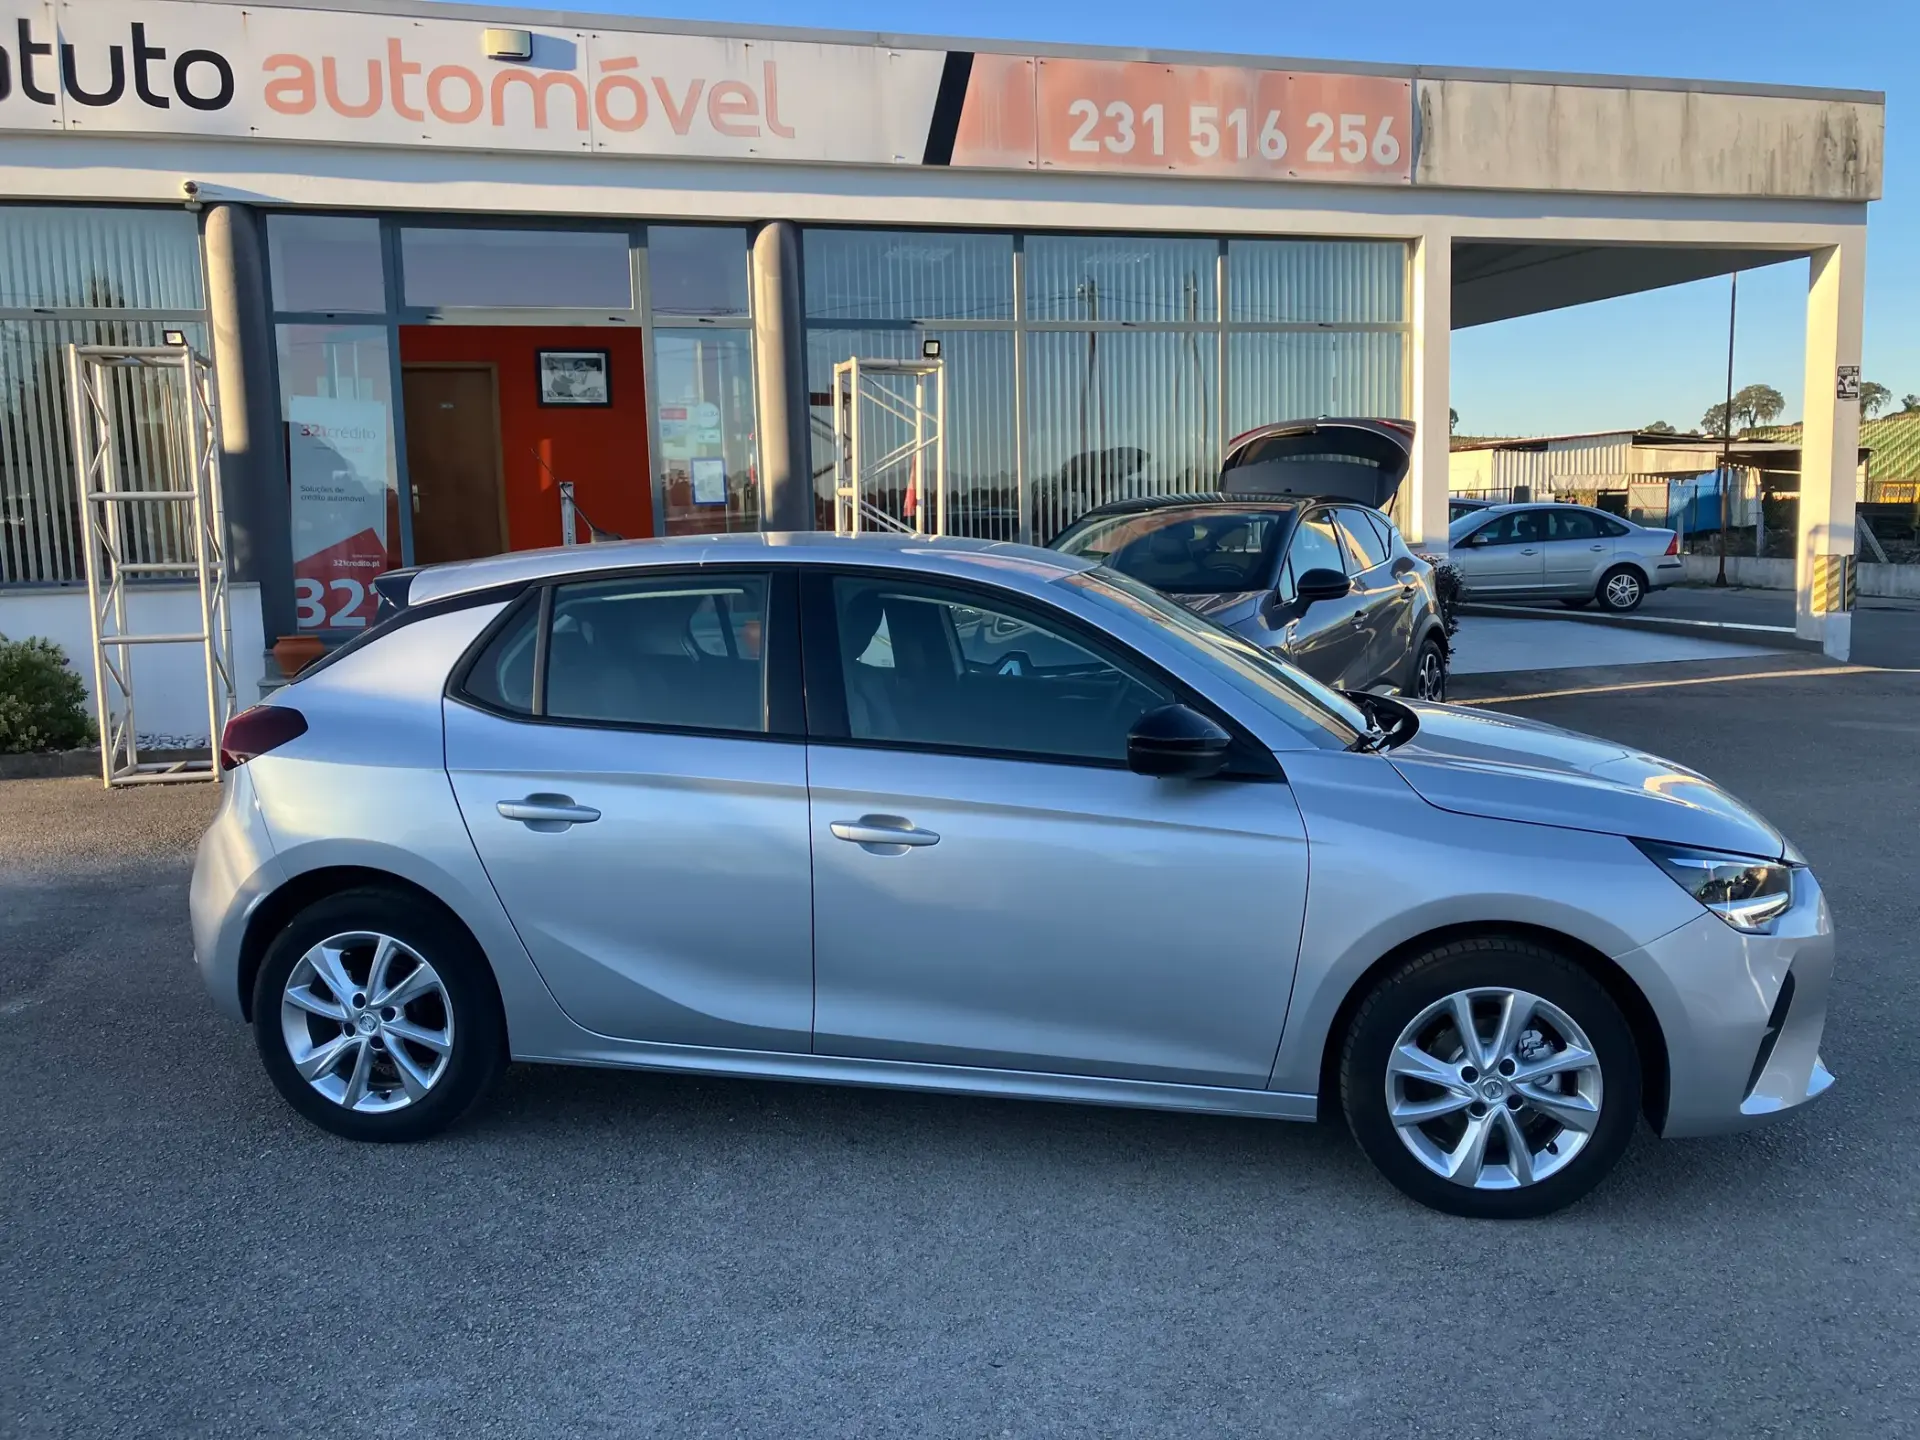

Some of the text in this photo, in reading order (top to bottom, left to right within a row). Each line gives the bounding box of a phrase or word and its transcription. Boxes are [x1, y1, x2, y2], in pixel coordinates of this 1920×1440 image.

[0, 18, 795, 139] tuto automóvel
[1068, 99, 1400, 166] 231 516 256
[335, 486, 345, 494] de
